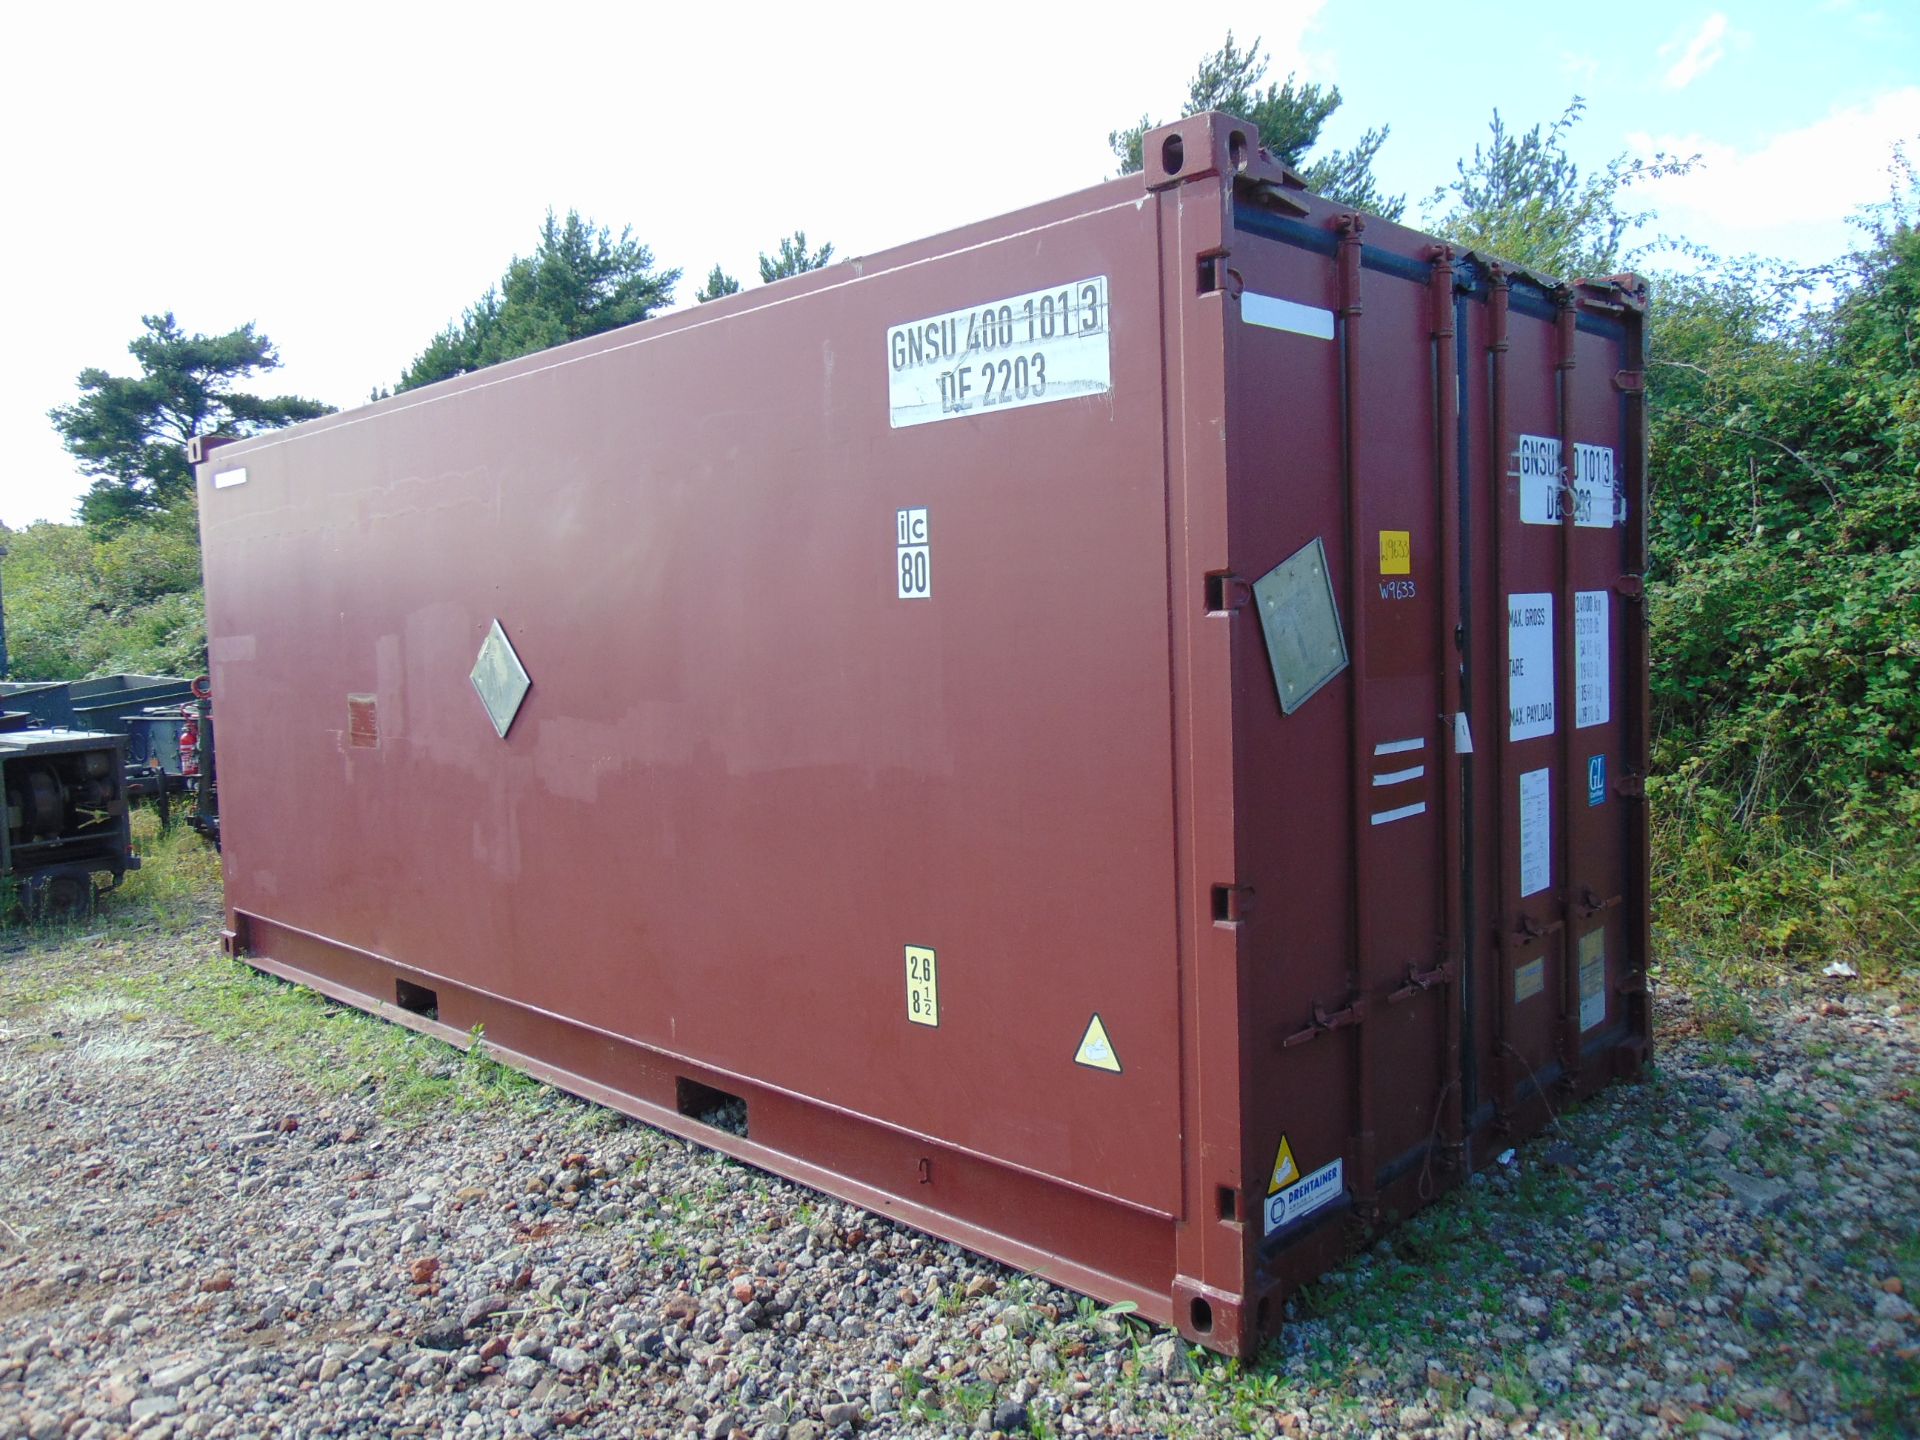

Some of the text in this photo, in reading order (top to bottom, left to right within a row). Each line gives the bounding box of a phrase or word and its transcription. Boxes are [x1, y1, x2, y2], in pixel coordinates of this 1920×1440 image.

[892, 318, 957, 372] GNSU
[966, 305, 1013, 354] 400
[982, 352, 1046, 407] 2203
[1522, 440, 1555, 476] GNSU
[902, 551, 926, 593] 80
[1379, 581, 1415, 600] W9633
[1525, 608, 1545, 626] GROSS
[1508, 658, 1524, 678] TARE
[1526, 703, 1552, 724] PAYLOAD
[1590, 758, 1604, 791] GL
[1288, 1167, 1338, 1204] DREHTAINER
